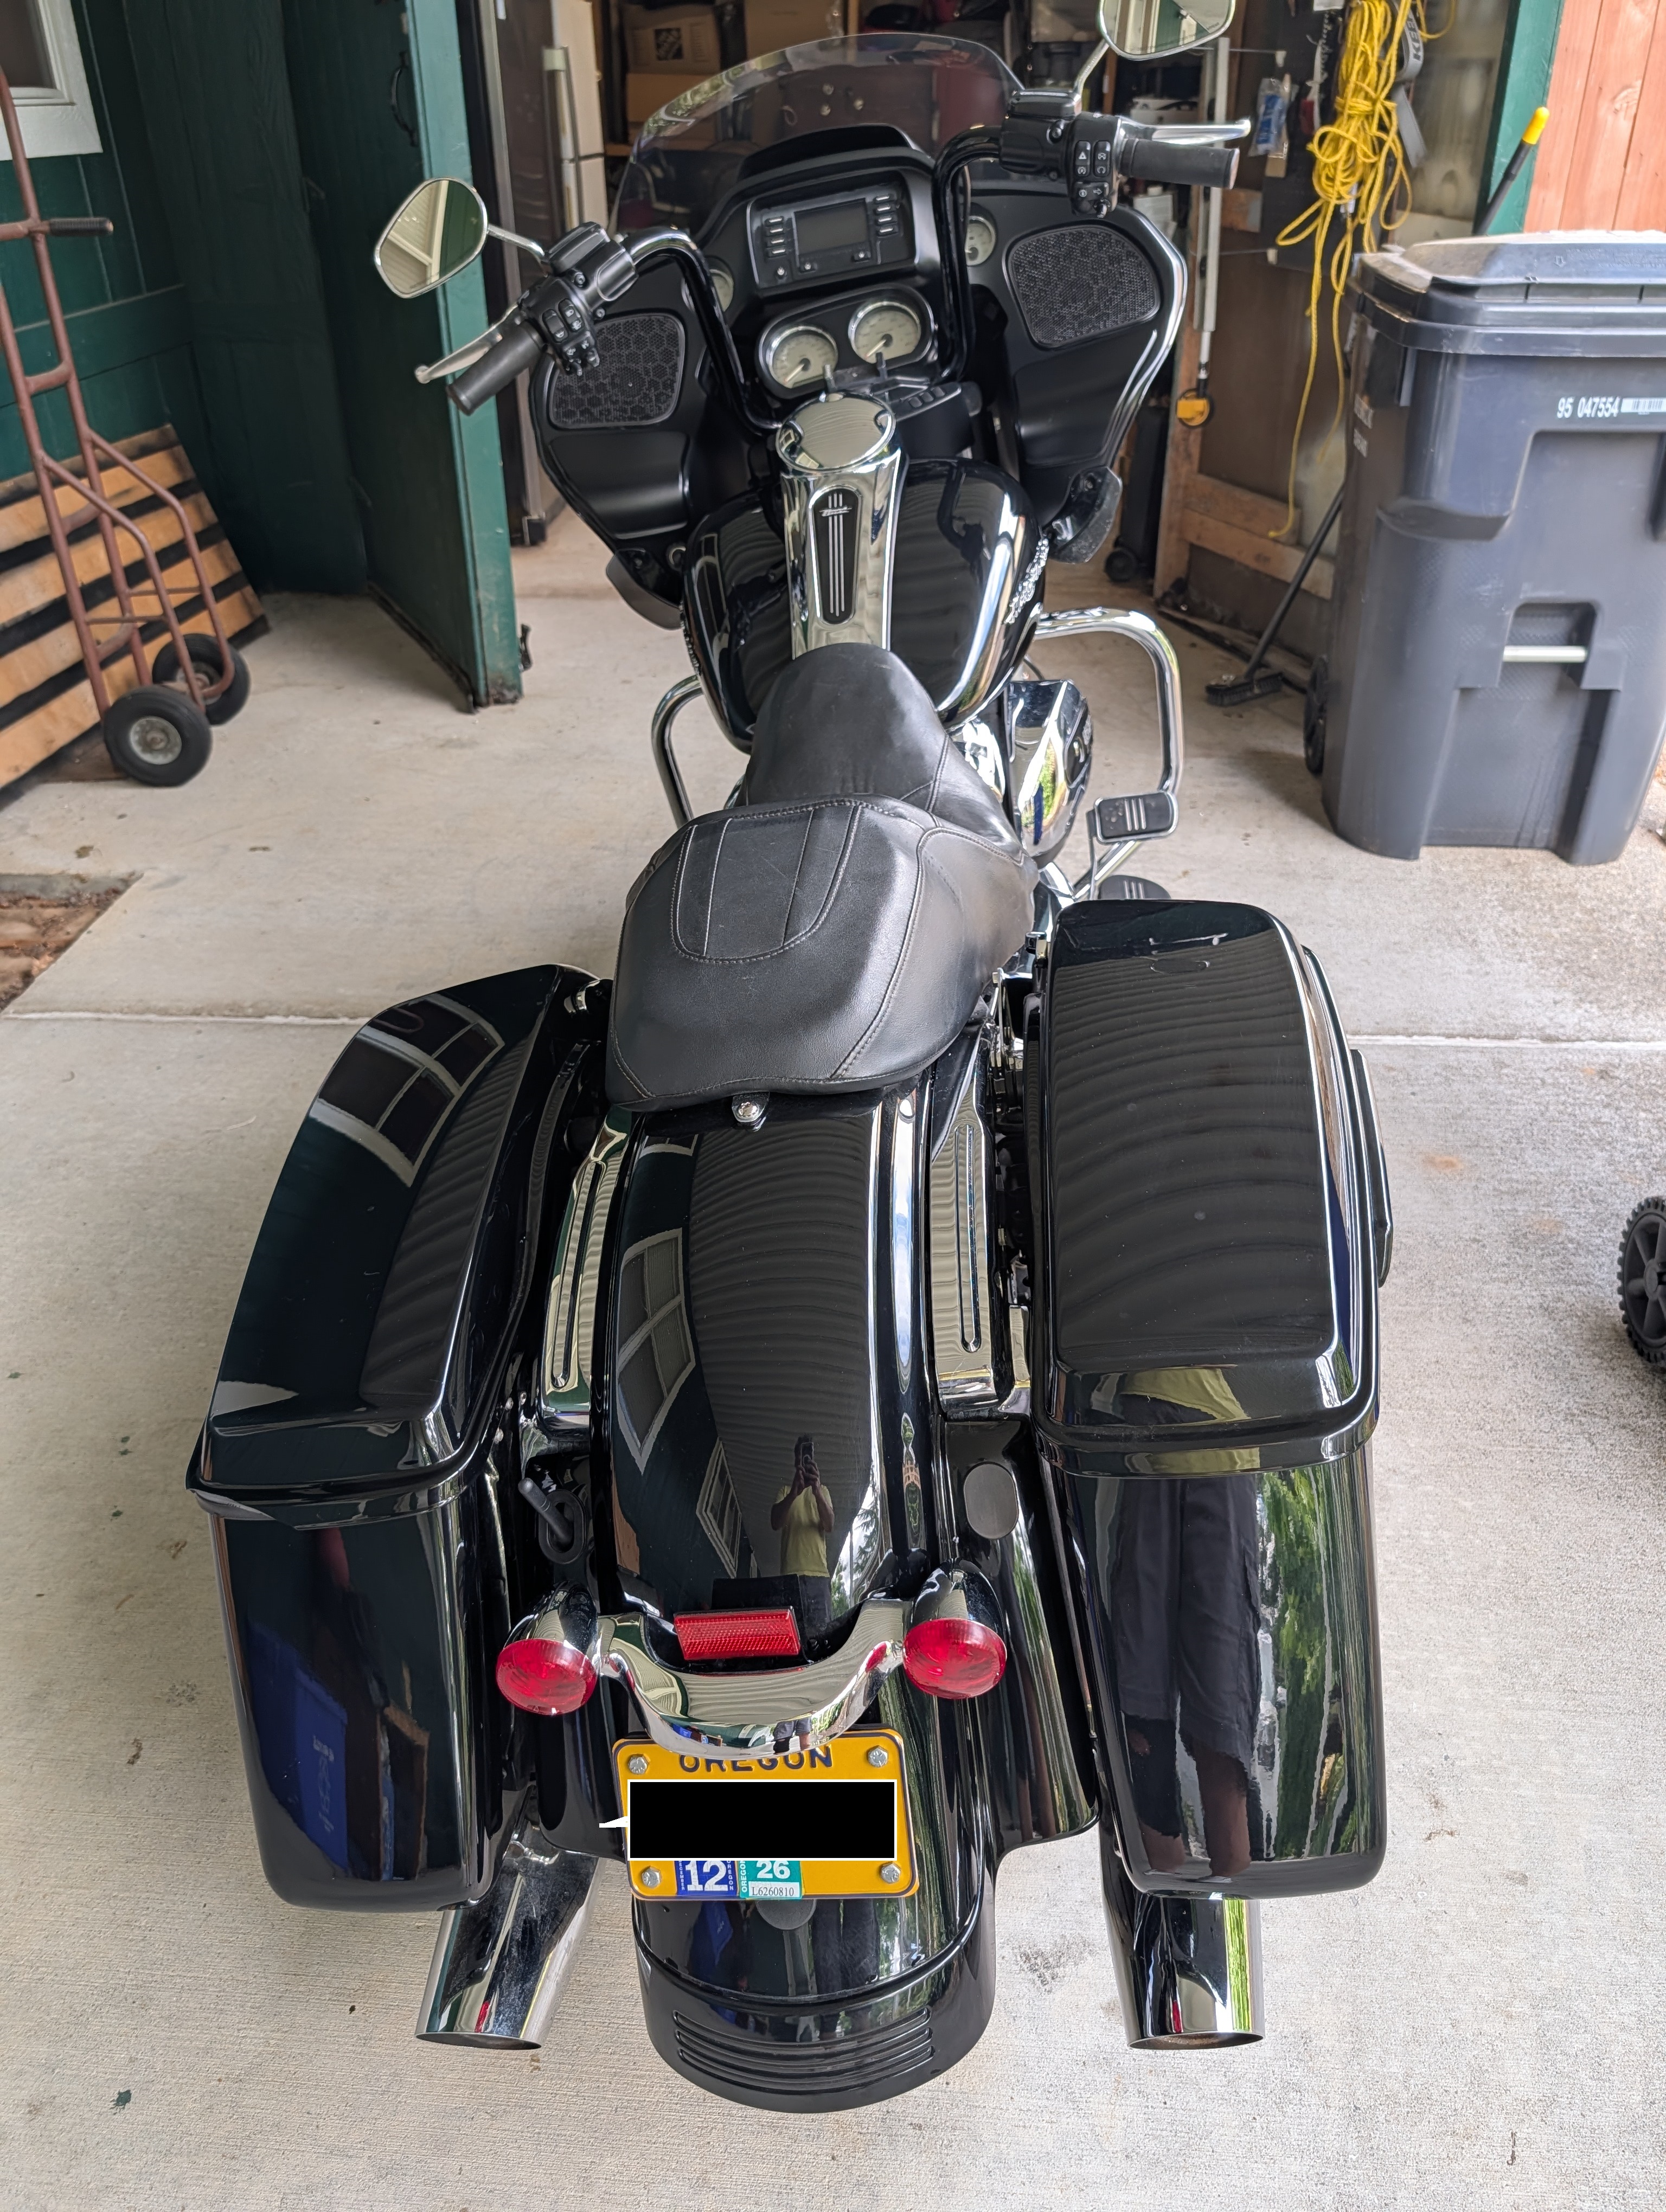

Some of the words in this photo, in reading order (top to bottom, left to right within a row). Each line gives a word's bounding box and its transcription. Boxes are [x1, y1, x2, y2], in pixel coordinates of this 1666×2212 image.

[1406, 18, 1420, 60] KEE
[1557, 397, 1574, 418] 95
[1577, 396, 1620, 417] 047554
[685, 1861, 728, 1891] 12
[756, 1861, 791, 1879] 26
[752, 1887, 794, 1896] L6260810
